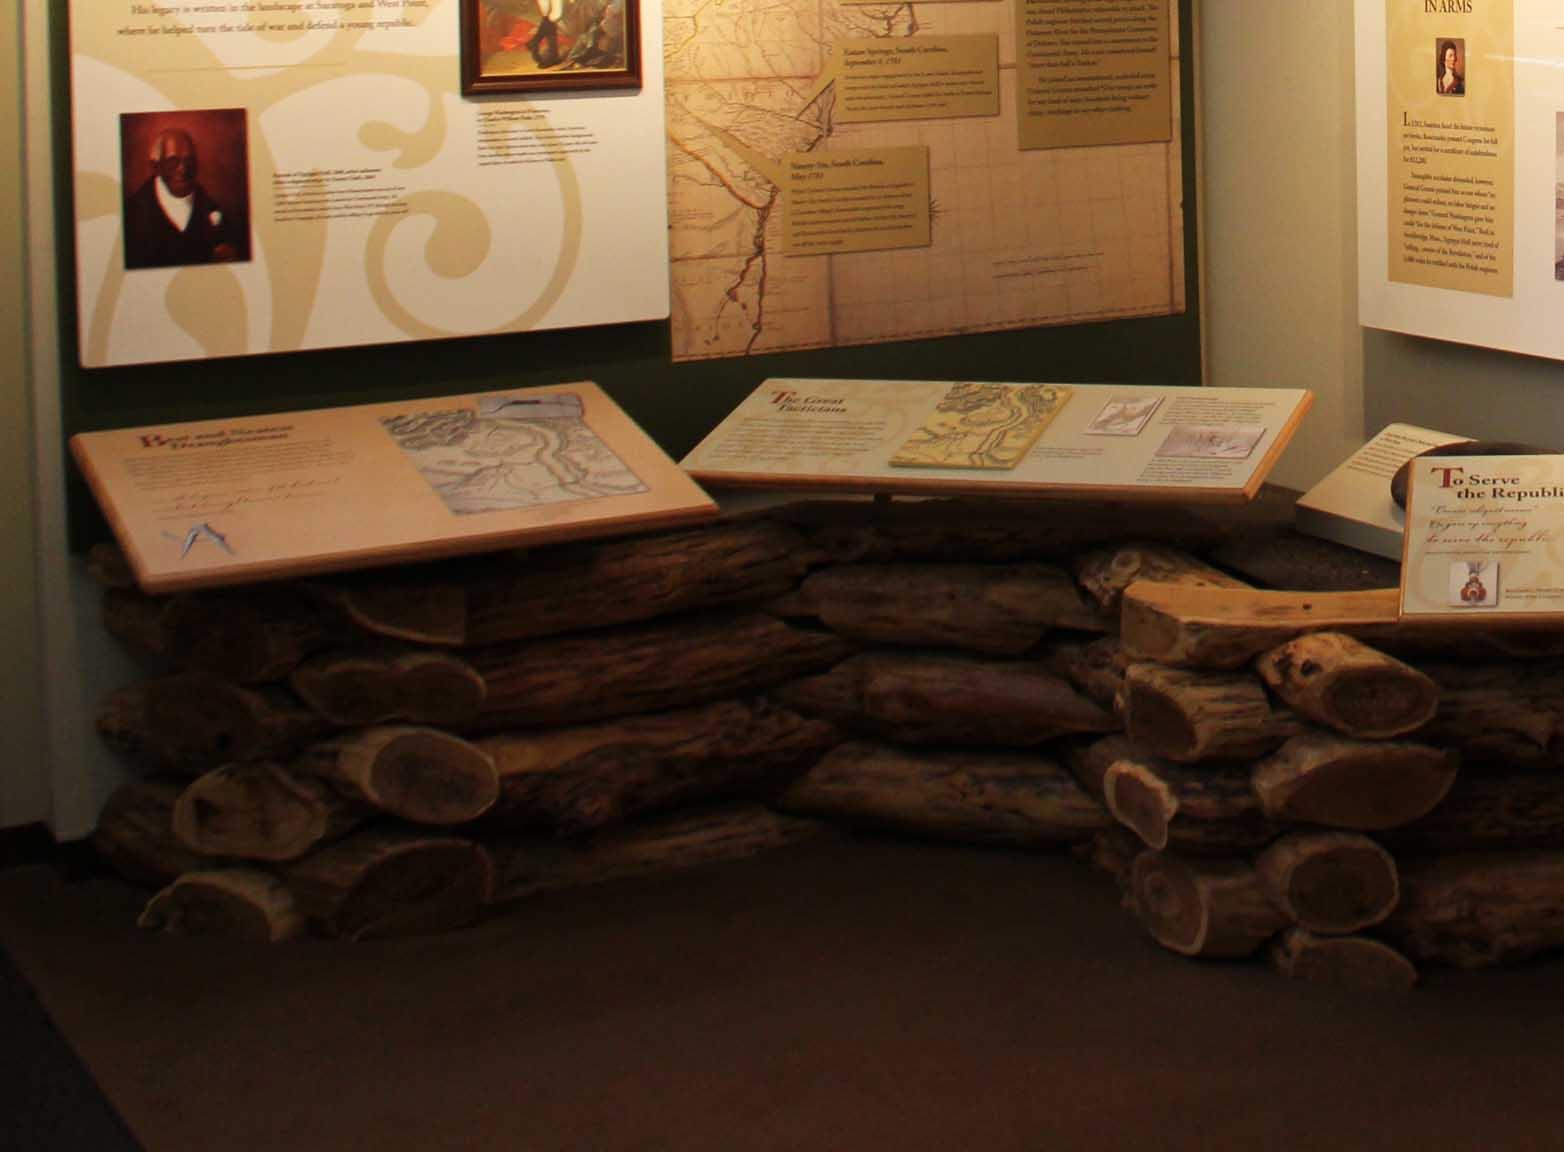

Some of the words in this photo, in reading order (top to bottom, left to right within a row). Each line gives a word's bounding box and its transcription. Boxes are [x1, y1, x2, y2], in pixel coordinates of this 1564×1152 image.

[1425, 0, 1437, 13] IN
[1437, 0, 1473, 14] ARMS
[770, 391, 800, 404] The
[804, 396, 845, 405] Great
[1431, 467, 1464, 489] To
[1469, 474, 1520, 486] Serve
[1457, 488, 1485, 499] the
